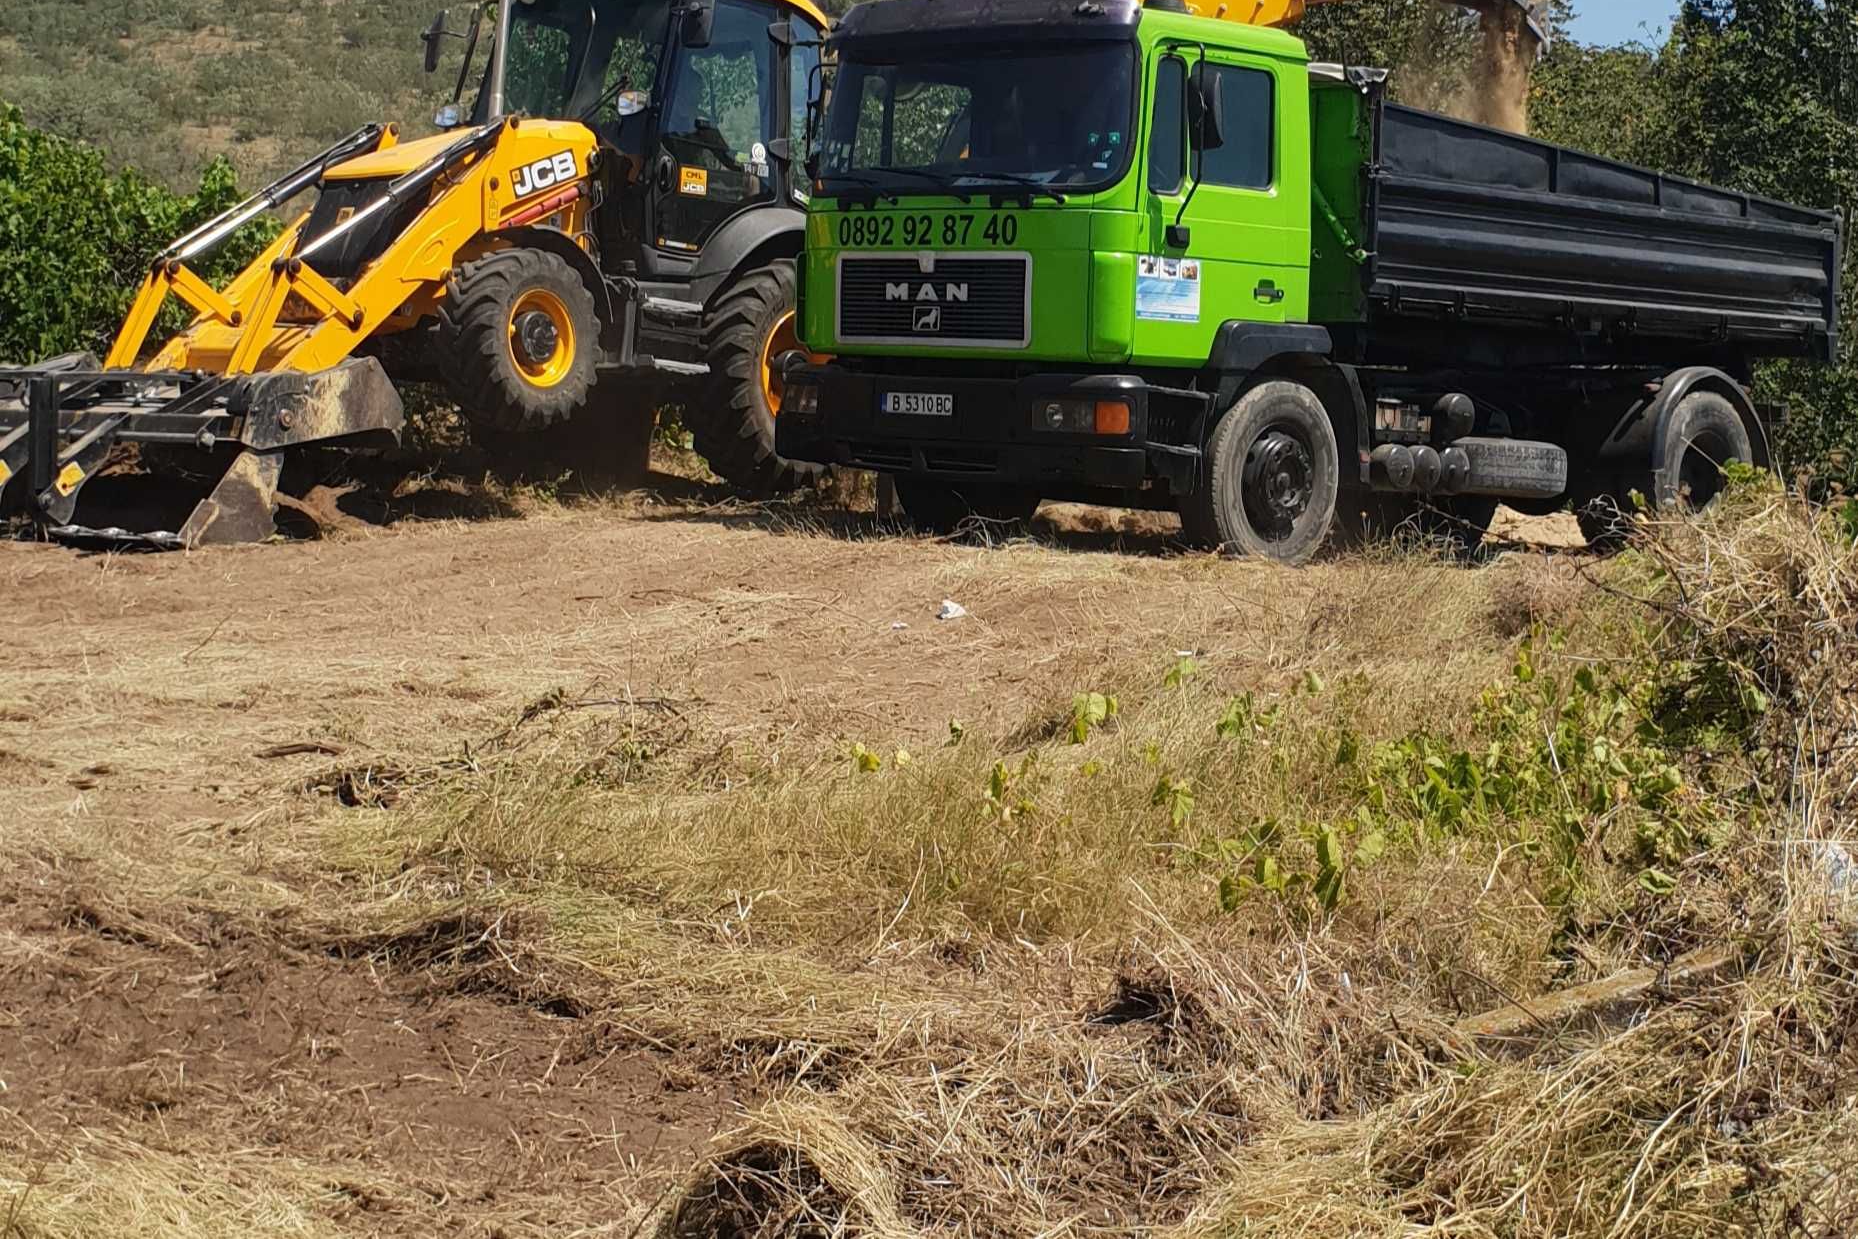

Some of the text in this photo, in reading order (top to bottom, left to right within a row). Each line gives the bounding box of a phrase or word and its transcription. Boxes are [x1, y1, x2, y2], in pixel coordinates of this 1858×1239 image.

[514, 151, 577, 196] JCB
[839, 214, 1018, 246] 0892 92 87 40
[885, 282, 968, 301] MAN
